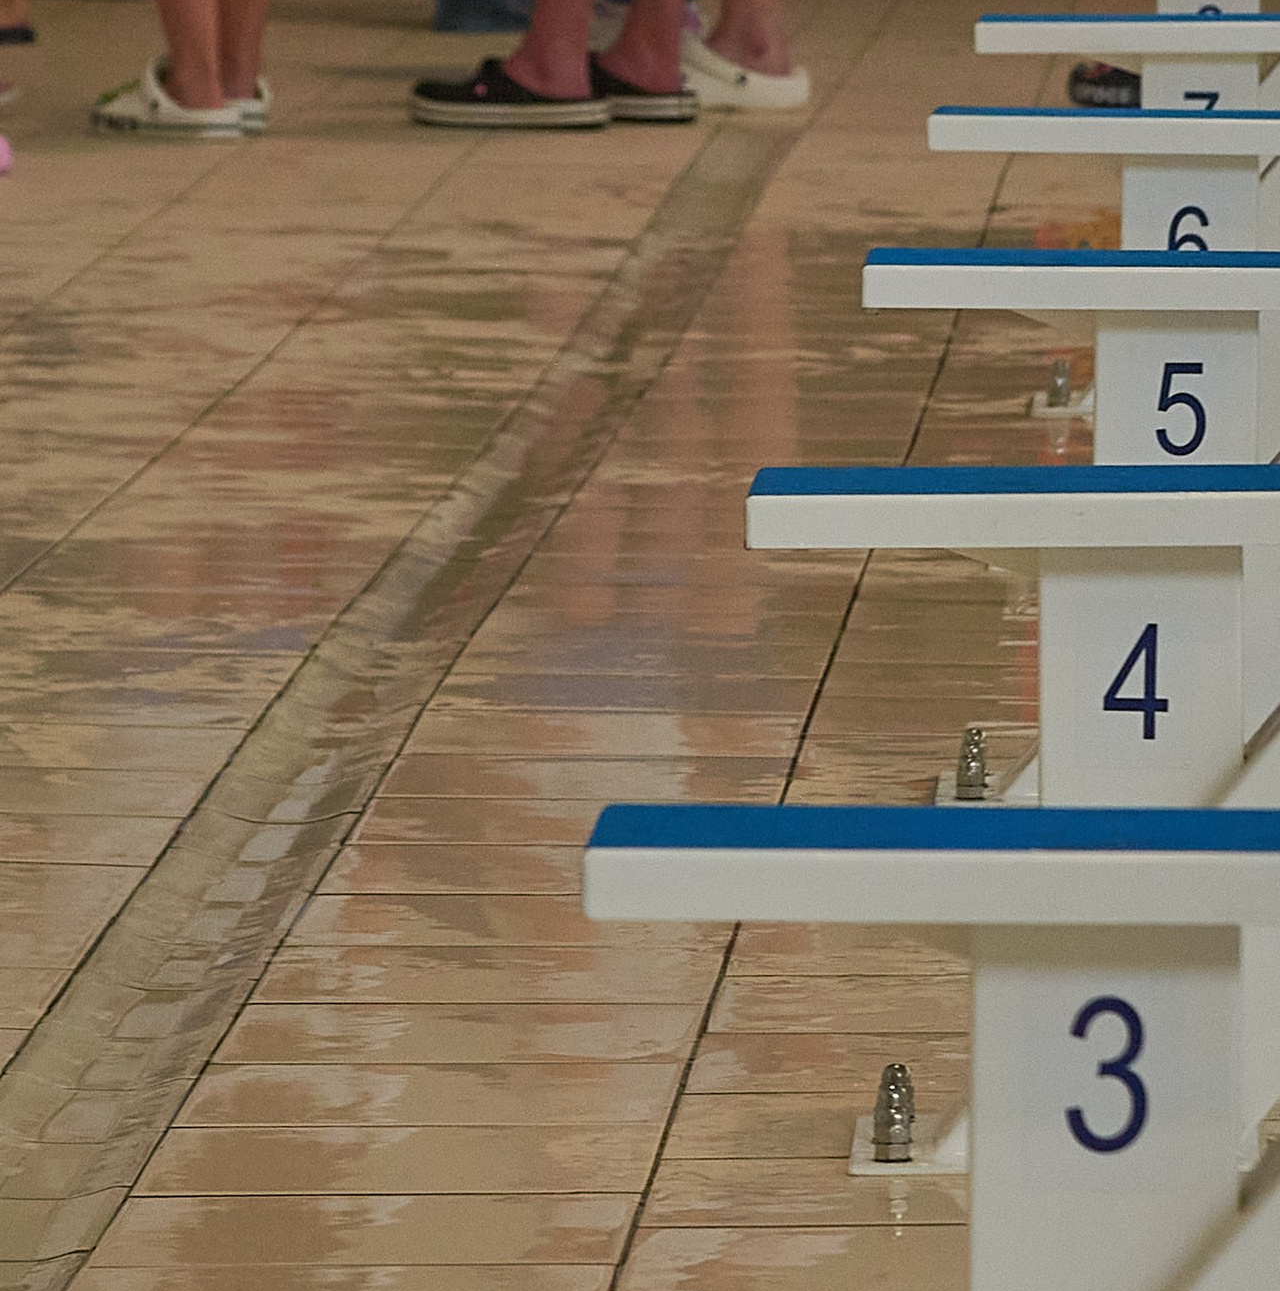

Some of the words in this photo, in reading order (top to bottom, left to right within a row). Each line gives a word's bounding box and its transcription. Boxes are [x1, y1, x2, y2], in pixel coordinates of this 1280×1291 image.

[1155, 362, 1207, 457] 5
[1102, 623, 1169, 740] 4
[1065, 995, 1149, 1154] 3
